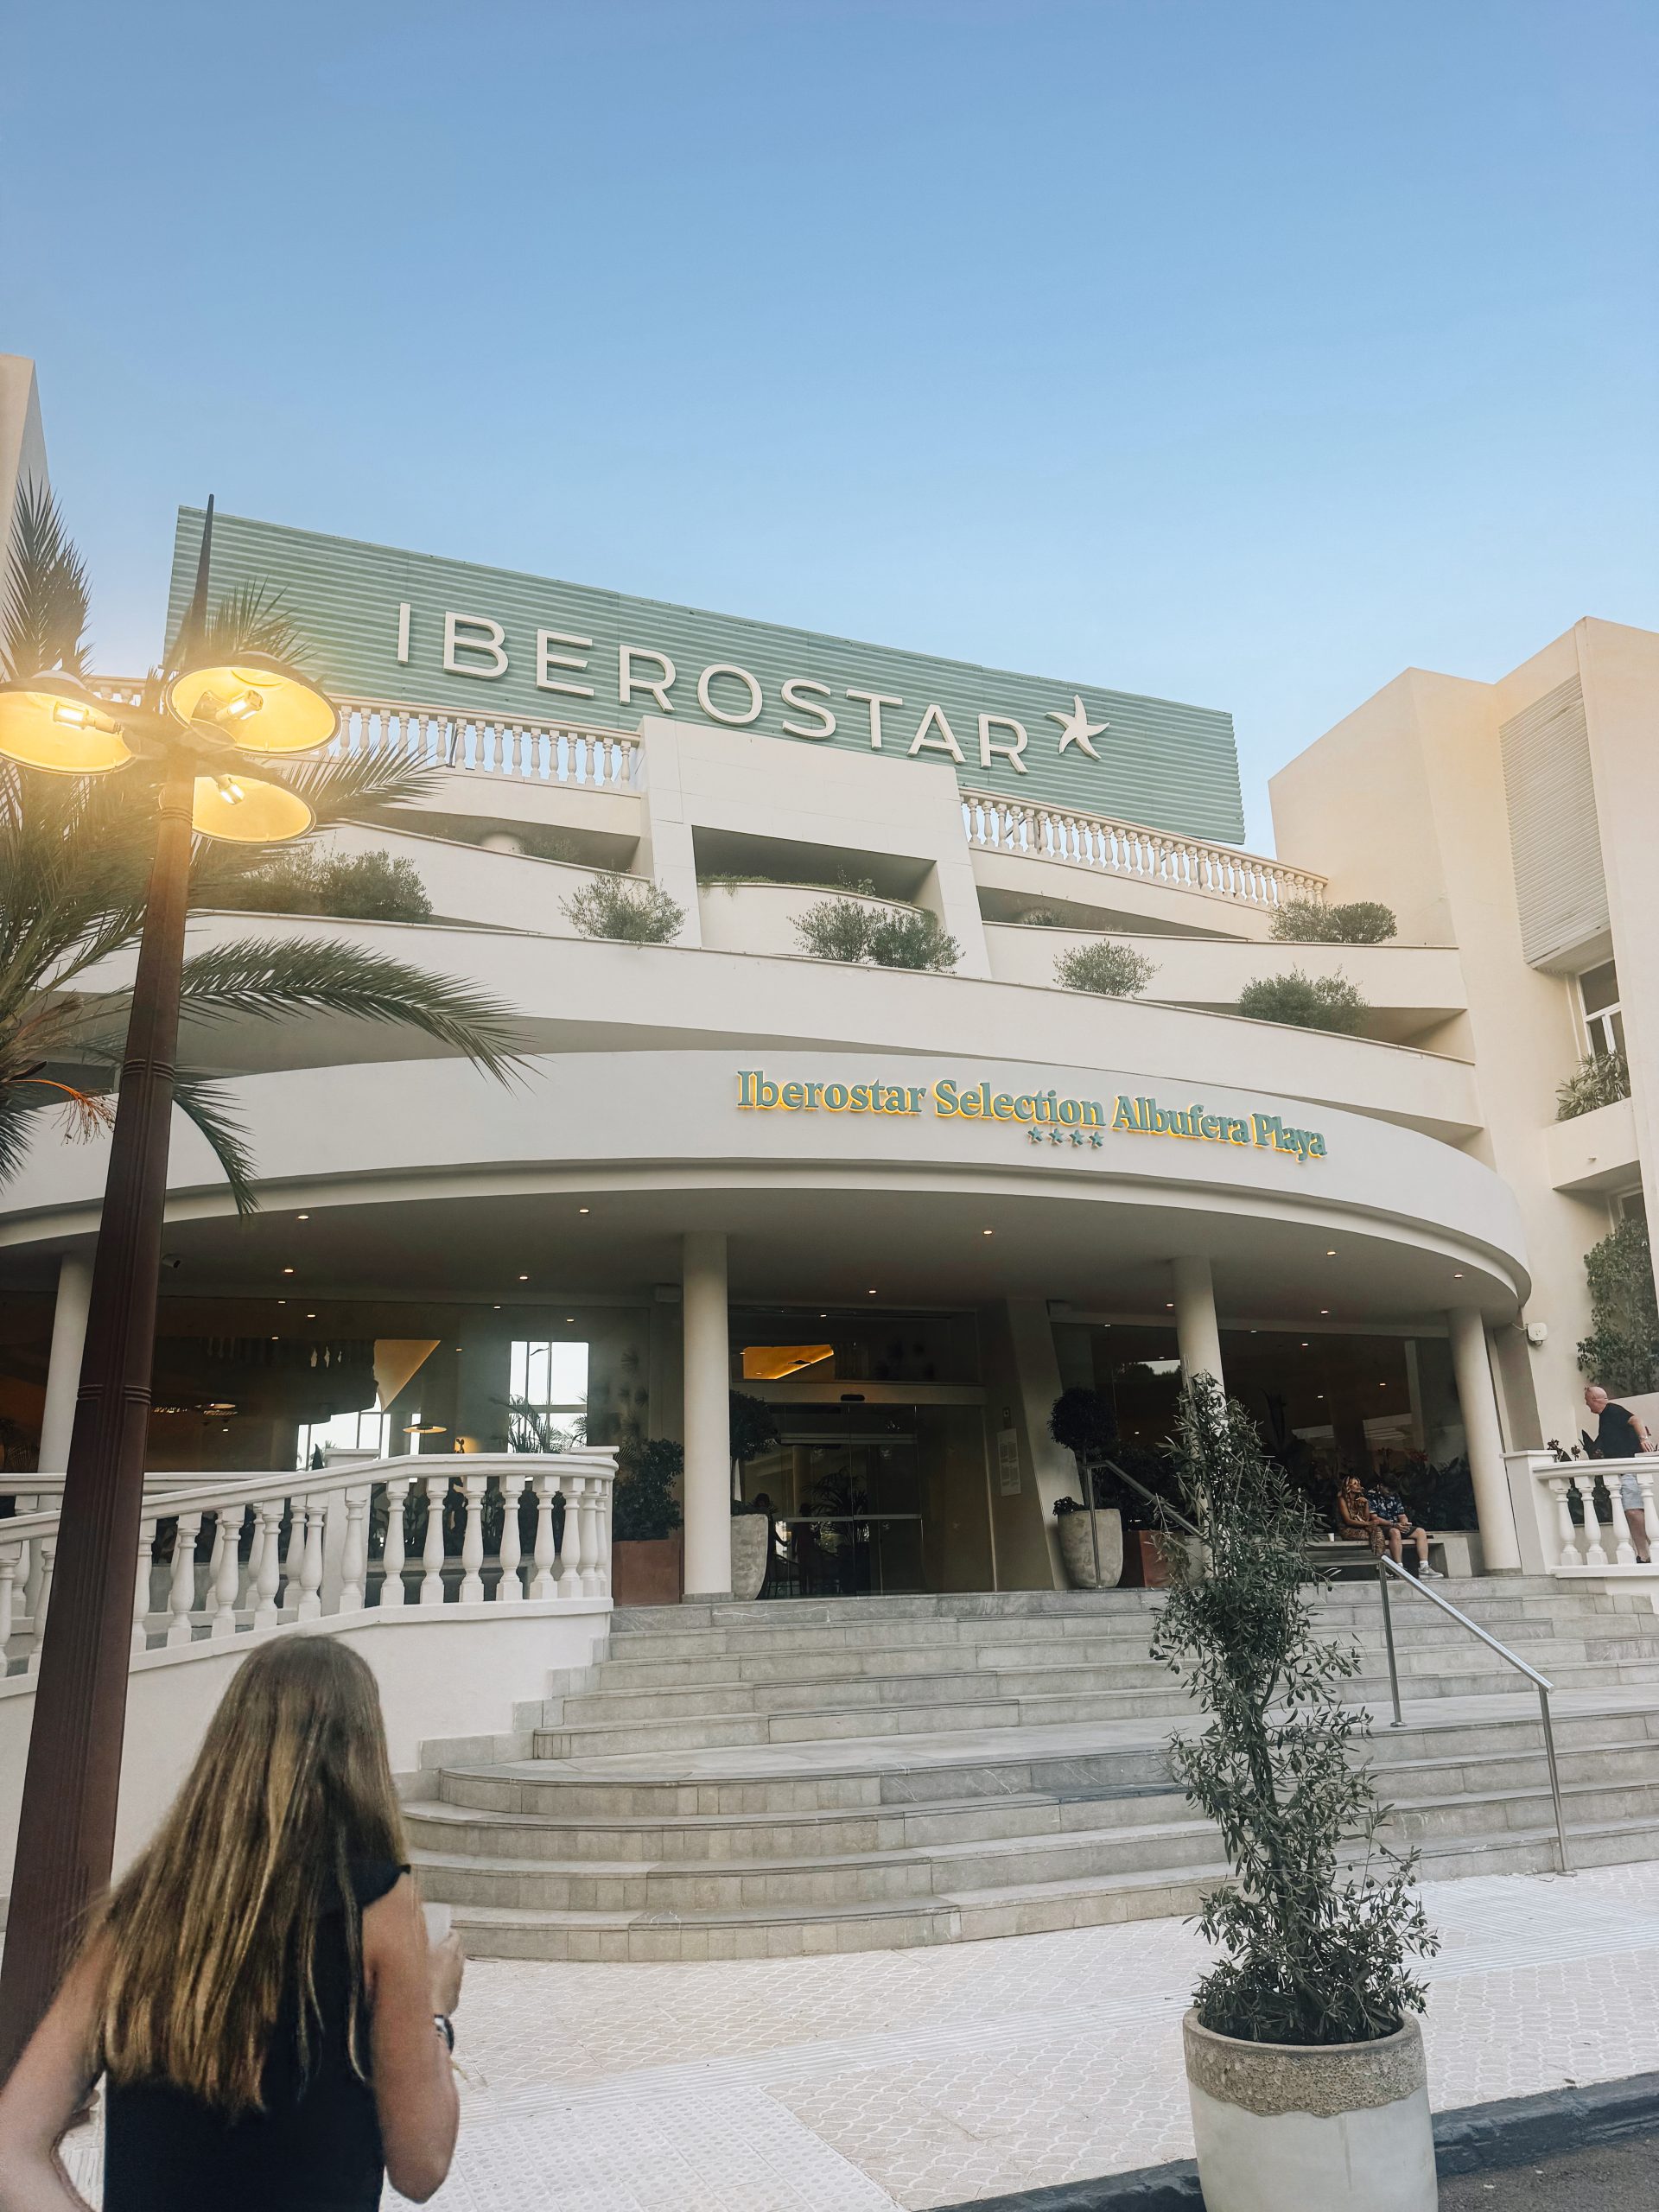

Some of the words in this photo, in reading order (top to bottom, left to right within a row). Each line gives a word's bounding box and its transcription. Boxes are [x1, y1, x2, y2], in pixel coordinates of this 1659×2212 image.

[397, 602, 1029, 775] IBEROSTAR
[737, 1070, 927, 1113] Iberostar
[935, 1079, 1107, 1127] Selection
[1112, 1095, 1251, 1143] Albufera
[1252, 1112, 1328, 1161] Playa
